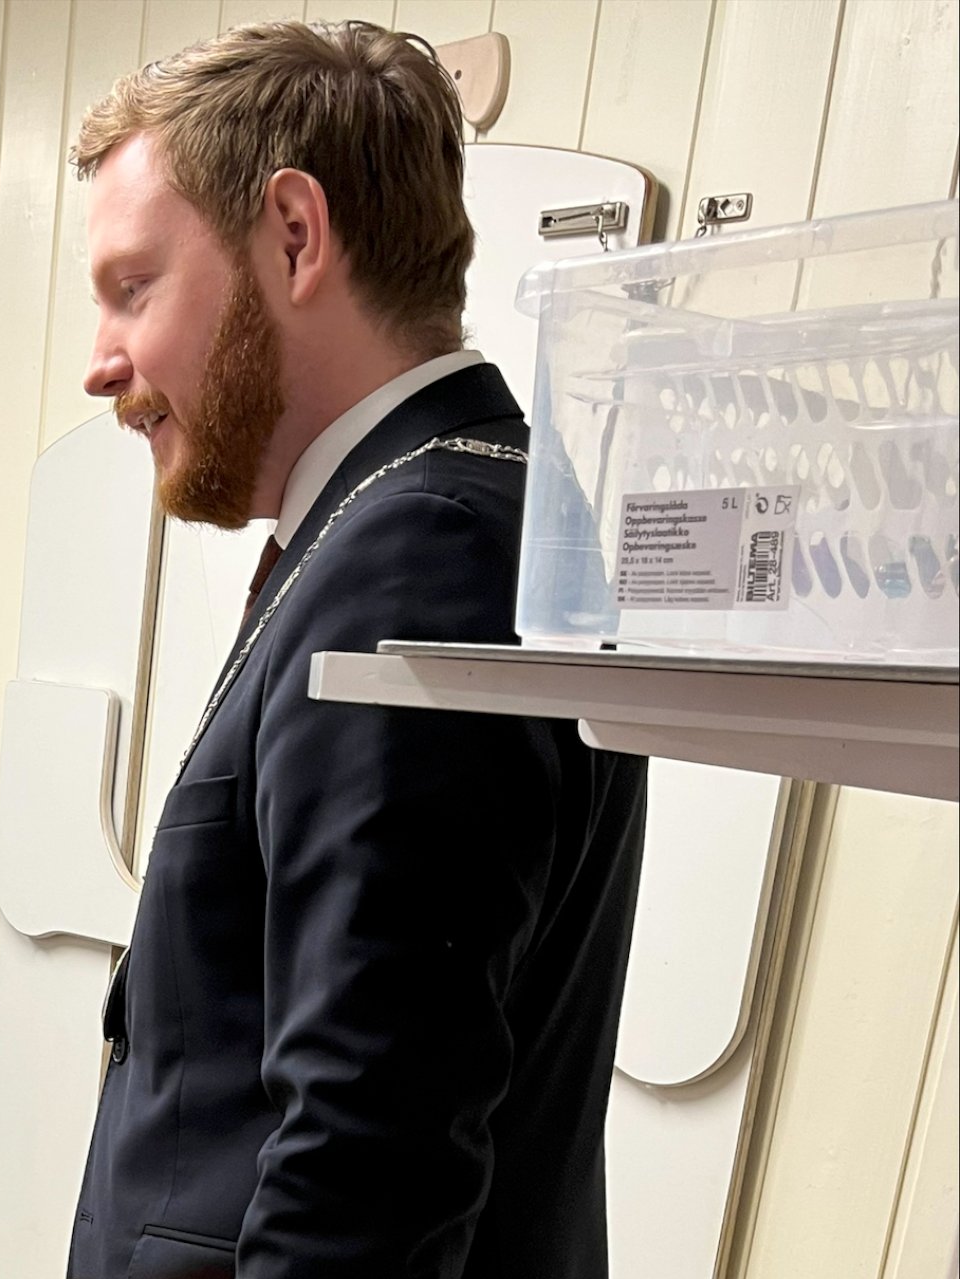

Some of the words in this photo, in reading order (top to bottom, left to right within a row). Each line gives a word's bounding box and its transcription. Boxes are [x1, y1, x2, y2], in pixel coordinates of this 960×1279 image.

[721, 497, 729, 510] 5
[731, 497, 739, 509] L
[745, 531, 758, 602] BILTEMA
